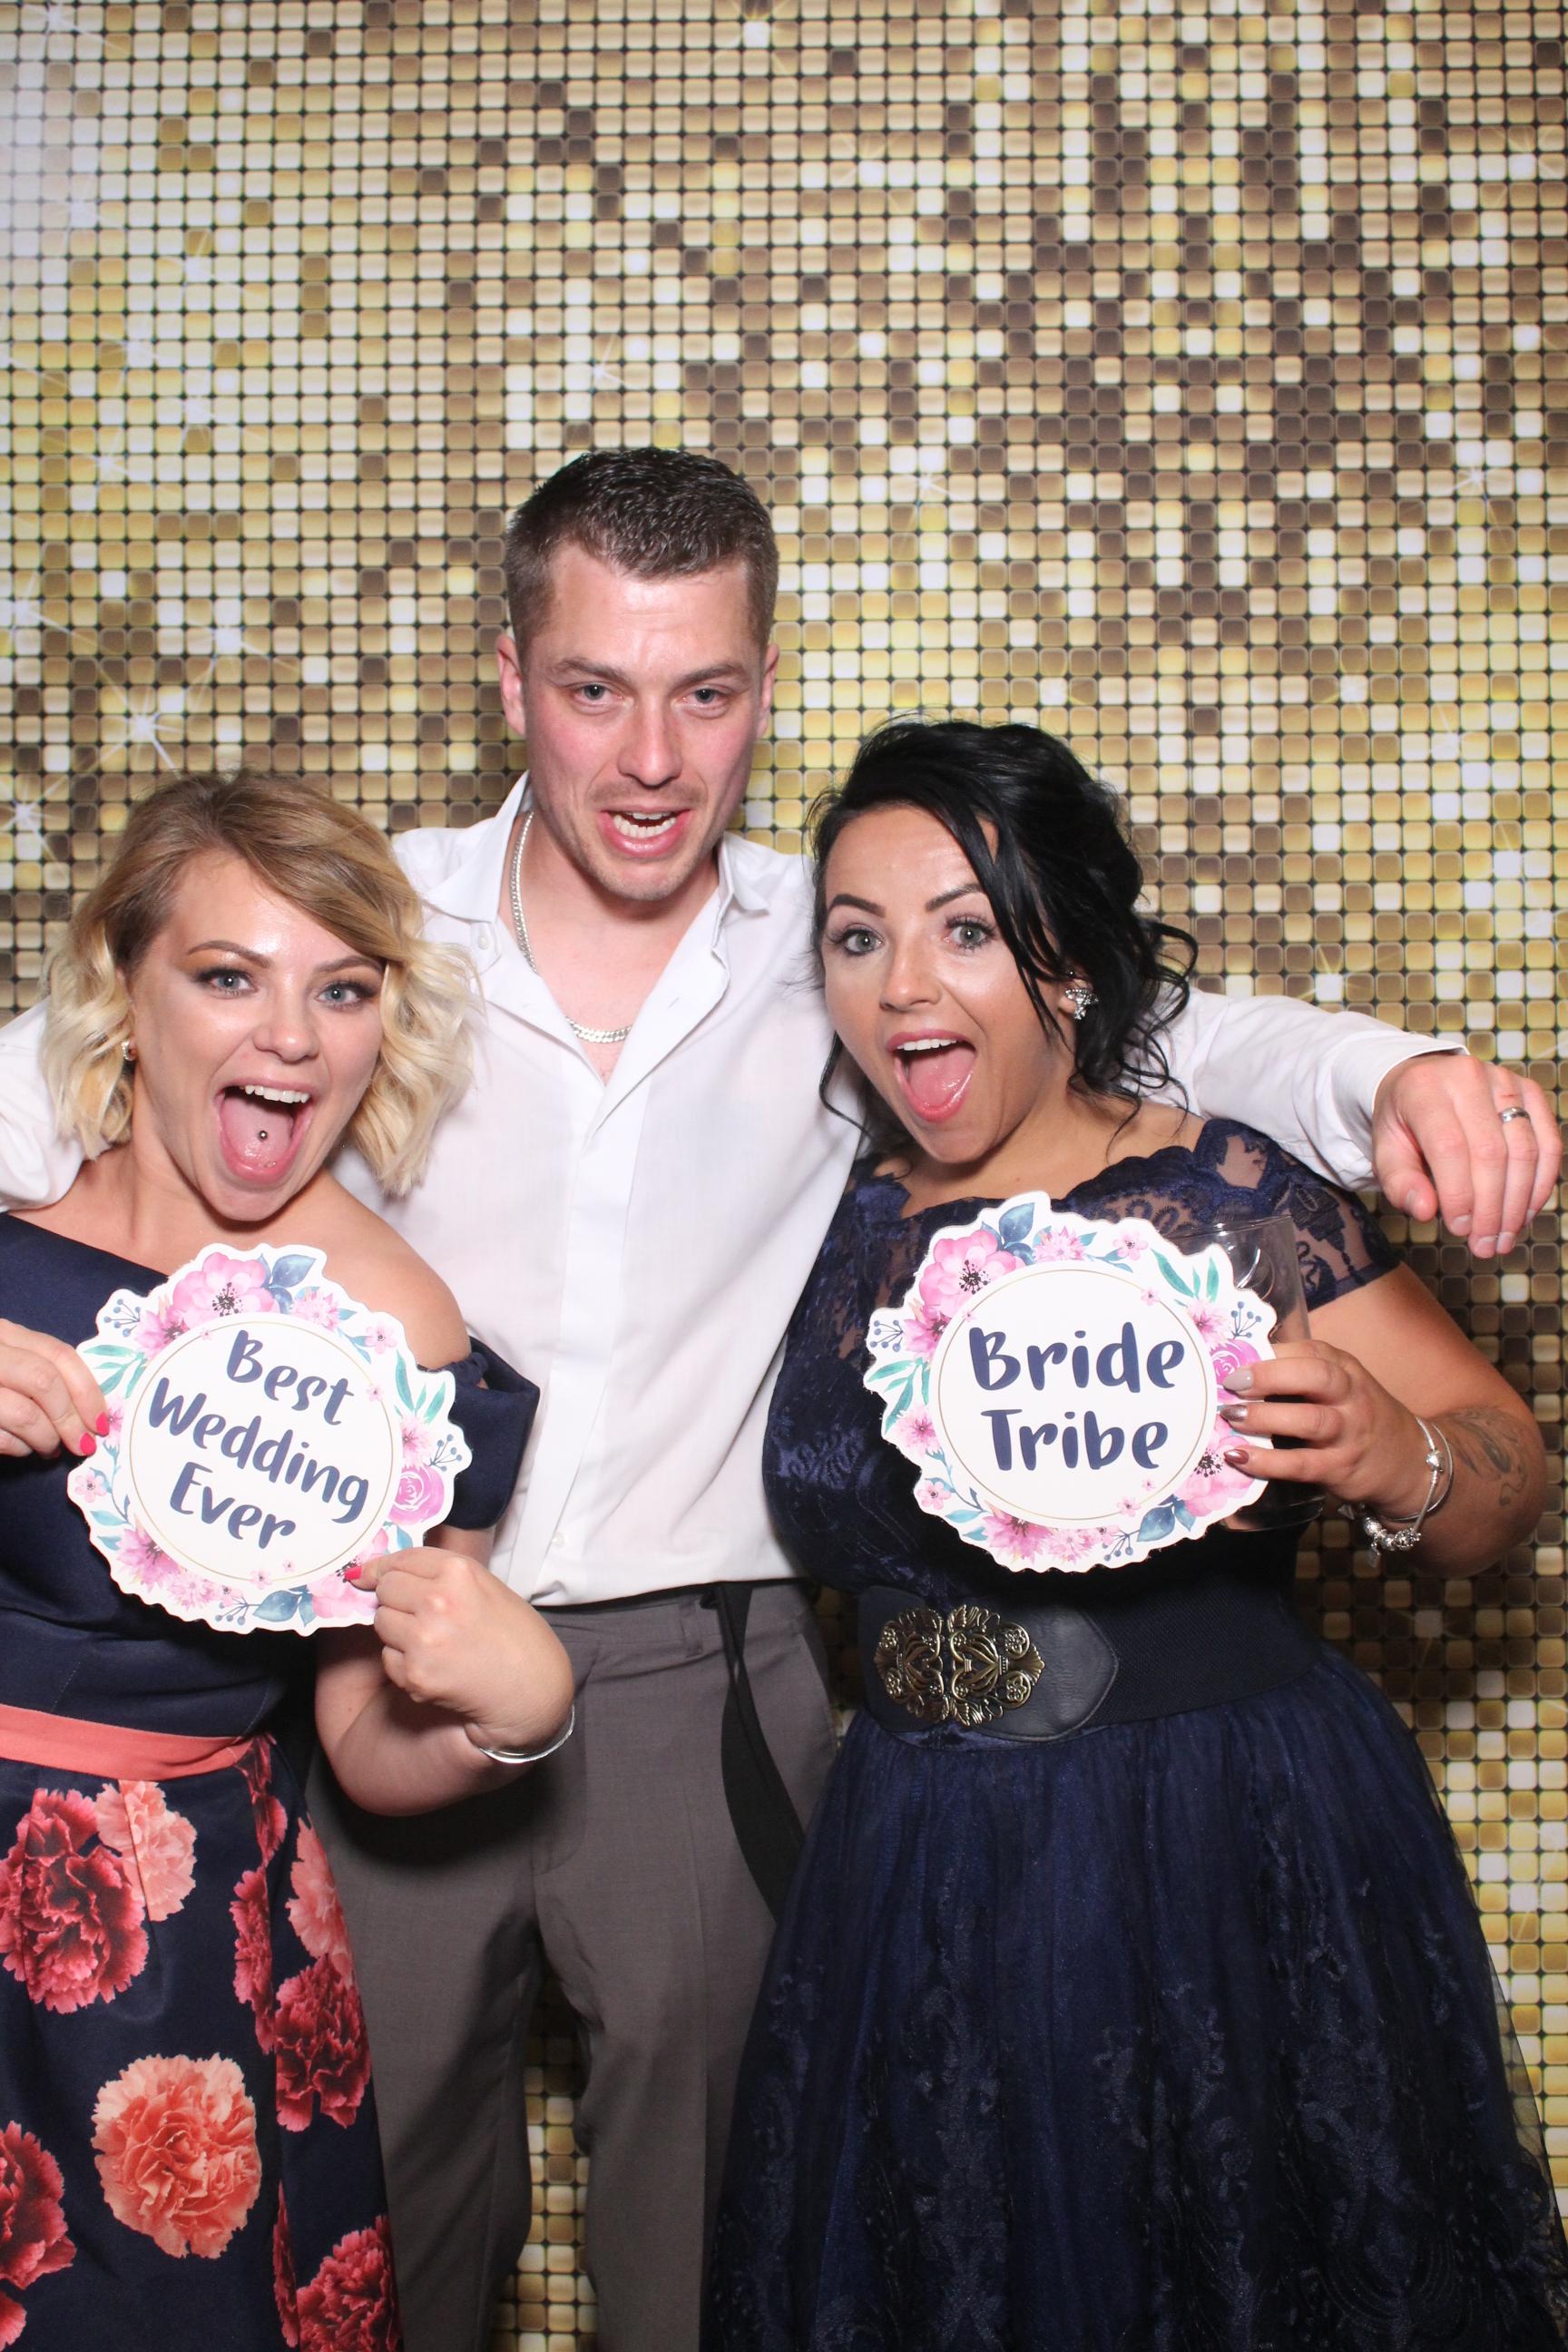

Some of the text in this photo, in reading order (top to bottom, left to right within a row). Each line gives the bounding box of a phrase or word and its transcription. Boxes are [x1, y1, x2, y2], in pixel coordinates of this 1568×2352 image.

[226, 1329, 355, 1426] Best
[968, 1321, 1185, 1394] Bride
[148, 1377, 369, 1524] Wedding
[980, 1408, 1169, 1471] Tribe
[169, 1461, 297, 1550] Ever
